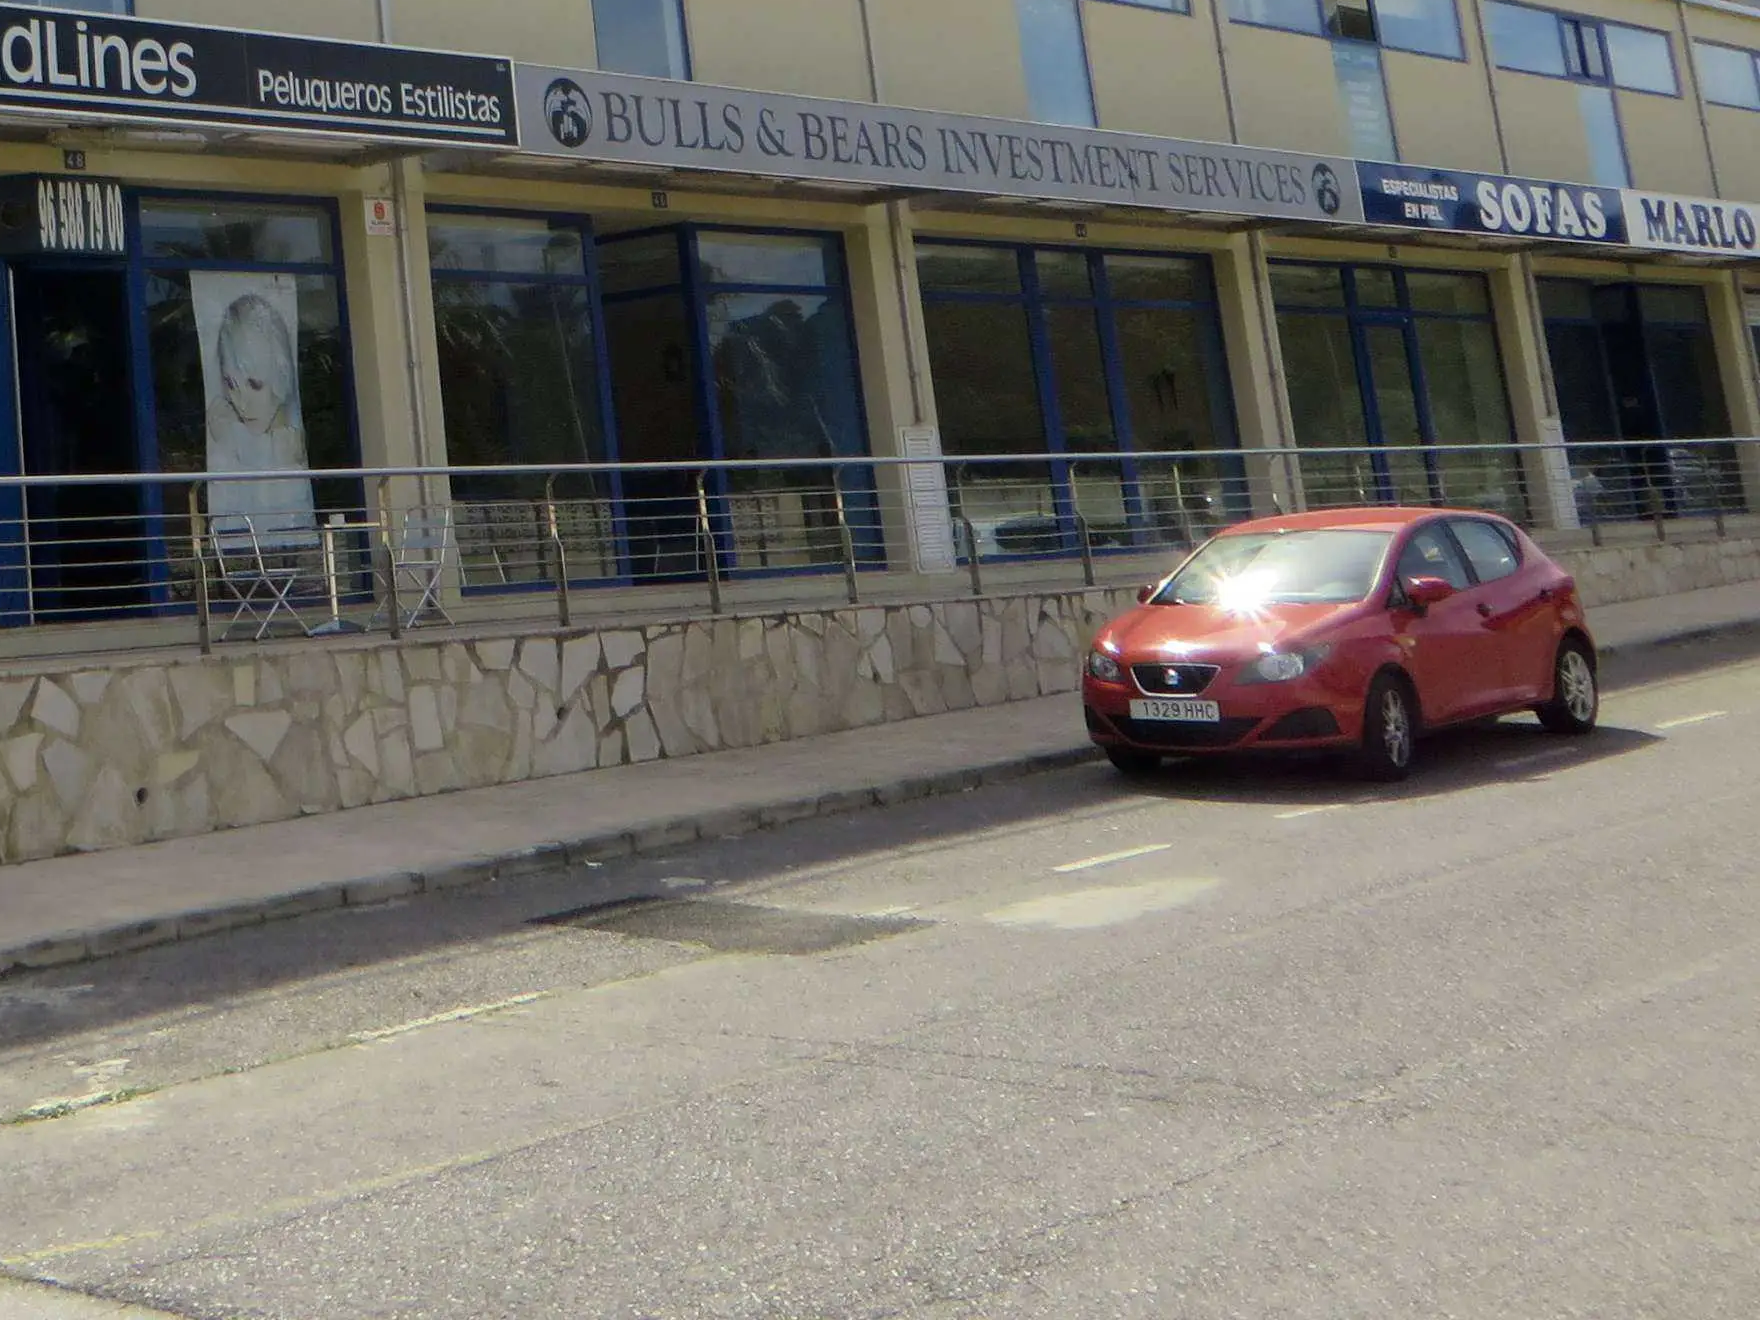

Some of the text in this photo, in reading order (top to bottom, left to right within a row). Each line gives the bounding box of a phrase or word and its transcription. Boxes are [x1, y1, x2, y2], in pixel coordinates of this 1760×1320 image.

[258, 68, 393, 115] Peluqueros
[401, 82, 501, 123] Estilistas
[67, 152, 84, 168] 48
[600, 90, 1307, 206] BULLS & BEARS INVESTMENT SERVICES
[38, 179, 125, 251] 96 588 79 00
[1476, 180, 1607, 239] SOFAS
[1640, 198, 1757, 250] MARLO
[1143, 702, 1181, 717] 1329
